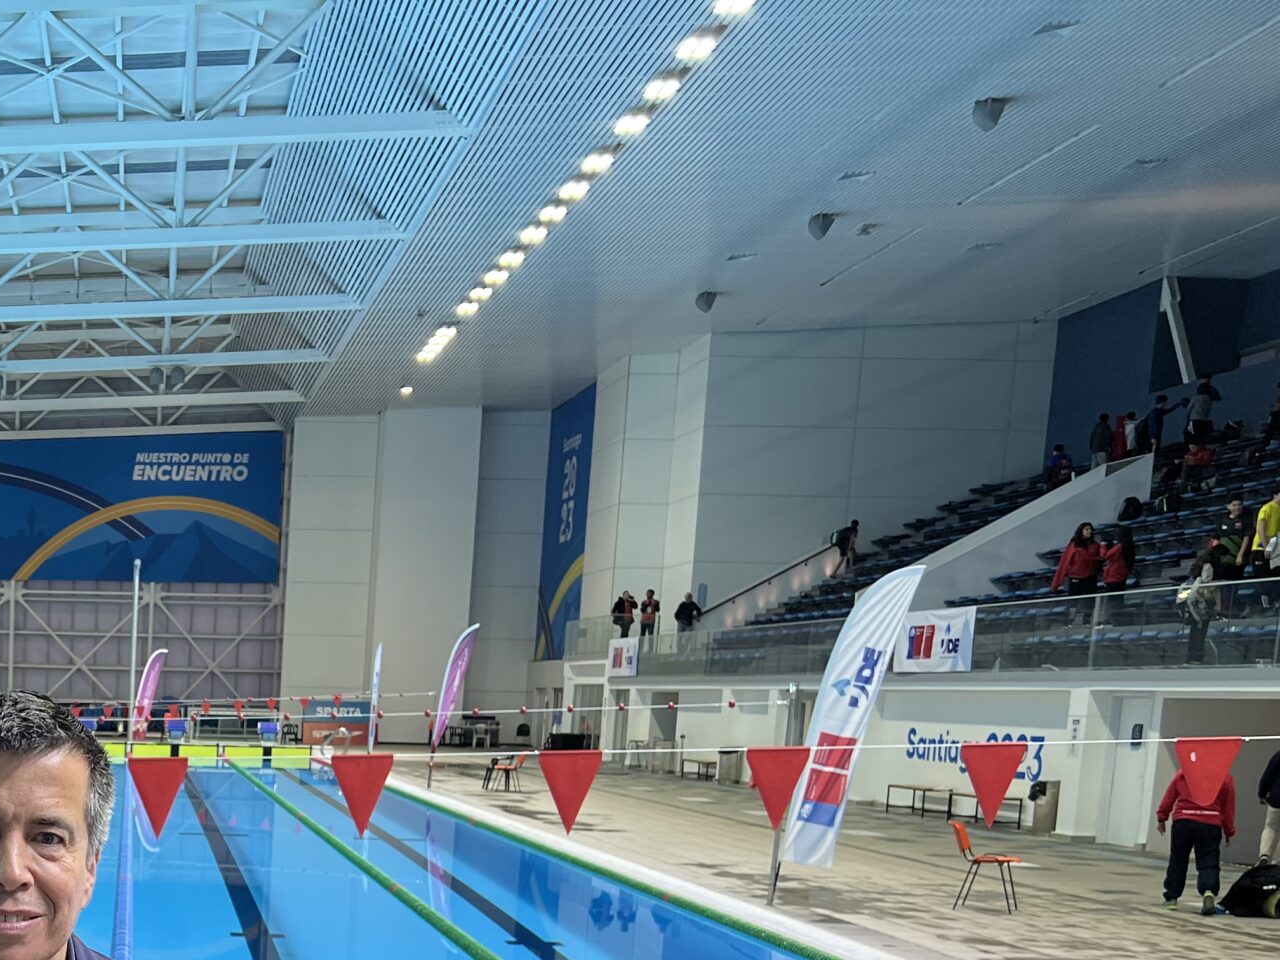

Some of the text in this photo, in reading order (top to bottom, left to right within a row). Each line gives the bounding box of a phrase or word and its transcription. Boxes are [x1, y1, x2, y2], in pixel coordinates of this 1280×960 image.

[135, 452, 250, 464] NUESTRO PUNTO DE
[132, 464, 249, 482] ENCUENTRO
